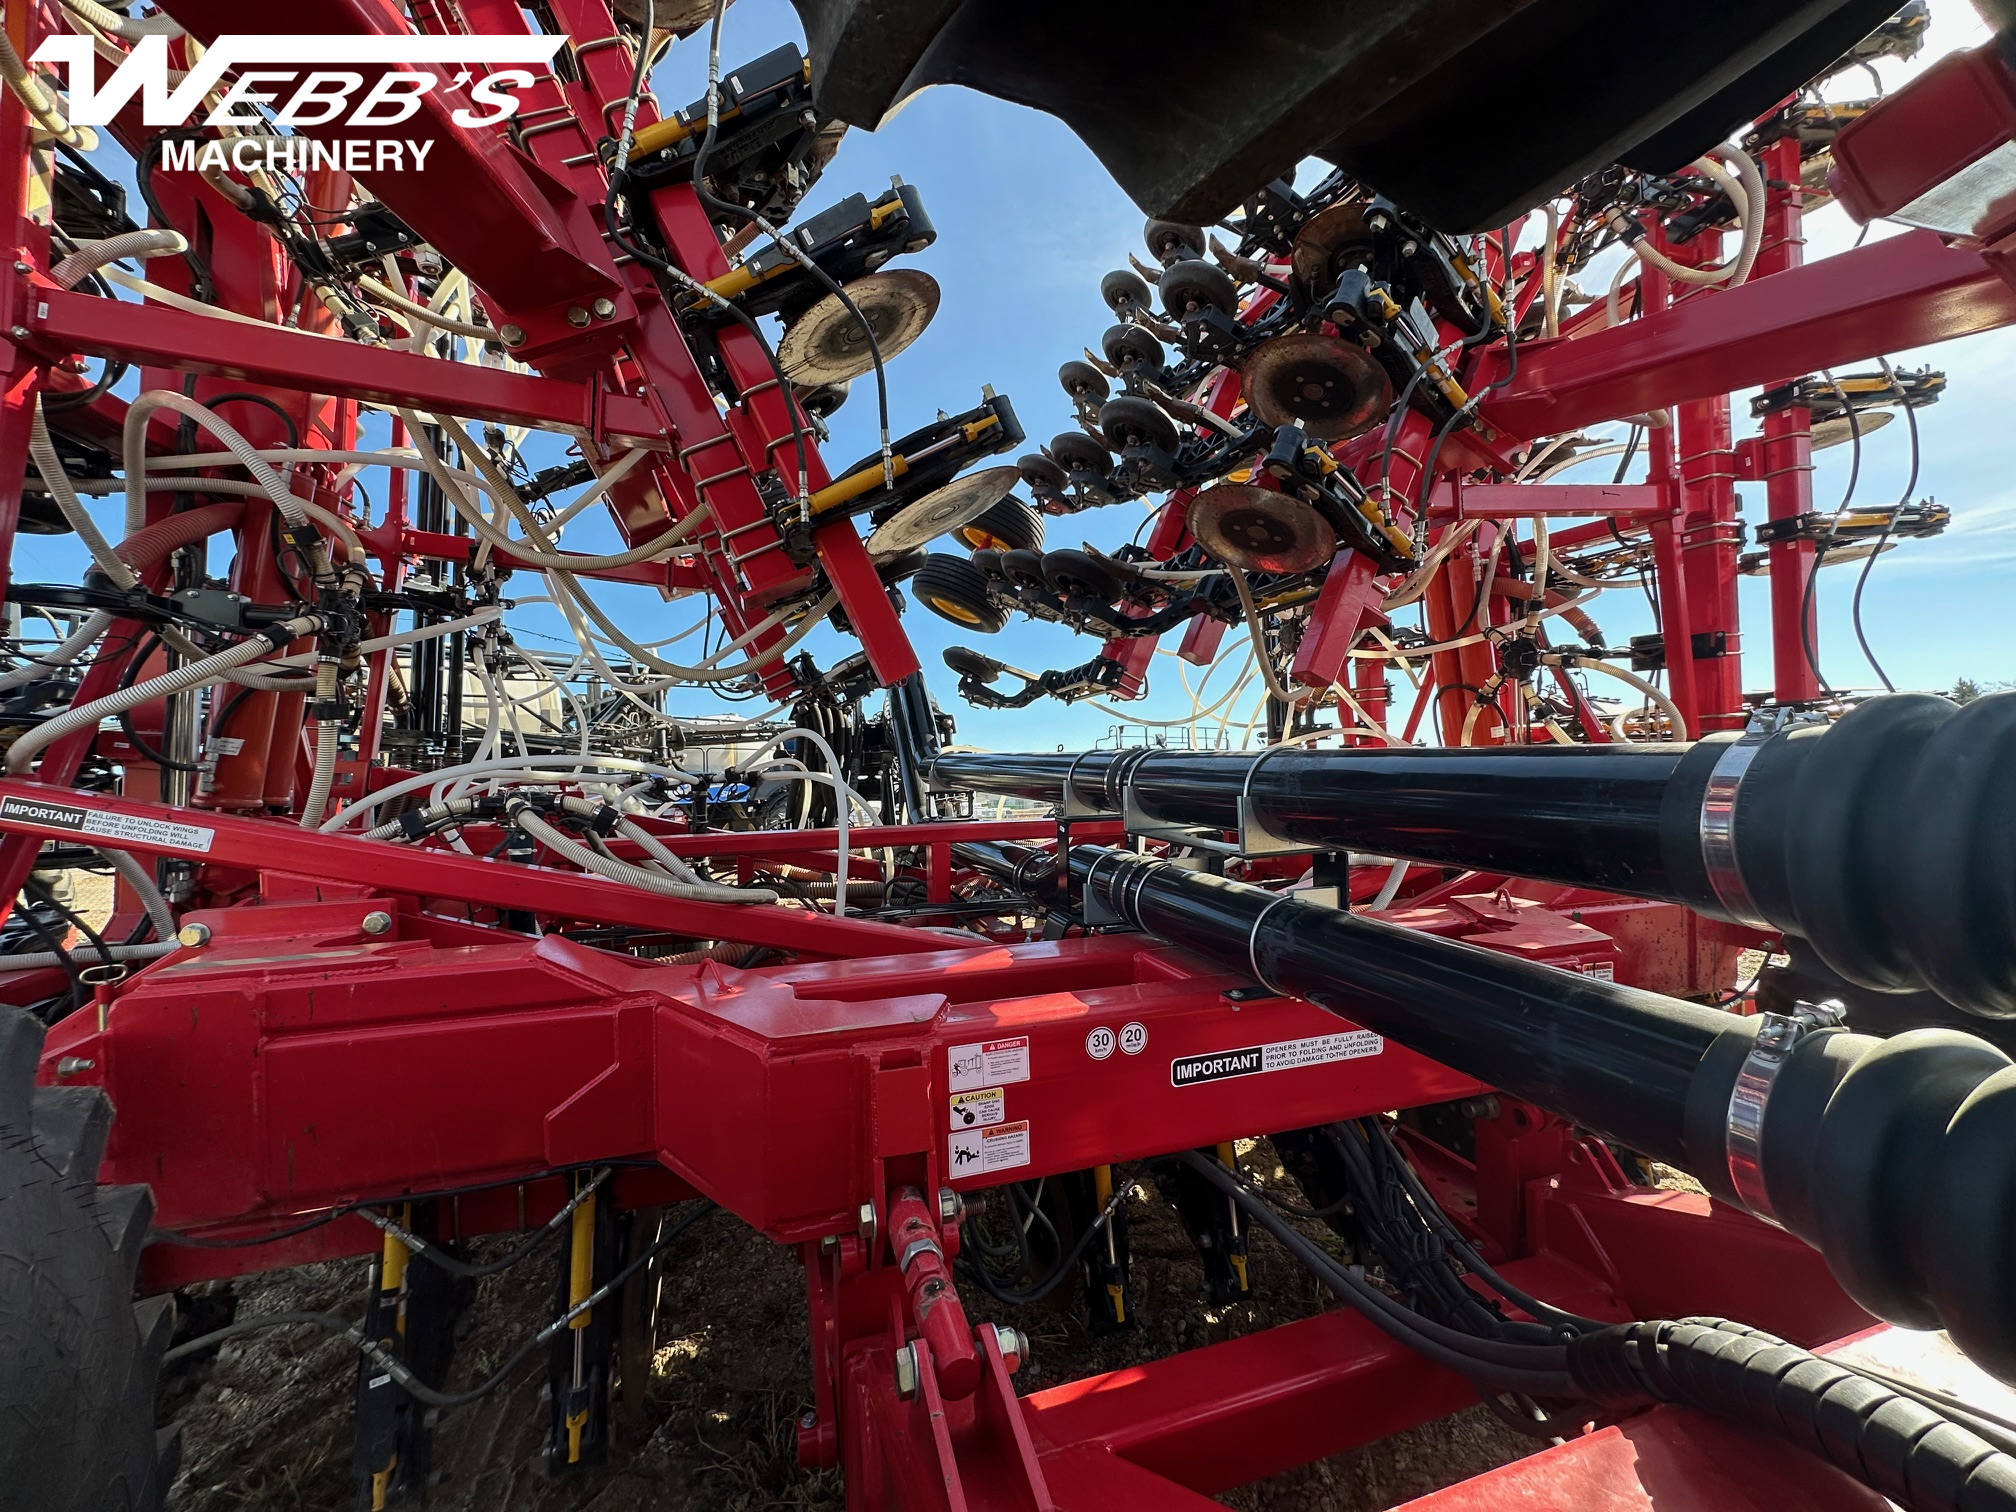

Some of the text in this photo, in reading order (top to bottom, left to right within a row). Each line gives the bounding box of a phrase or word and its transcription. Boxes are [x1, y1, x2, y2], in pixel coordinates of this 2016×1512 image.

[4, 802, 83, 824] IMPORTANT
[86, 818, 189, 840] BEFORE UNFOLDING WILL
[88, 811, 121, 822] FAILURE
[137, 820, 171, 831] UNLOCK
[172, 826, 199, 835] WINGS
[83, 825, 112, 835] CAUSE
[114, 830, 168, 844] STRUCTURAL
[997, 1040, 1021, 1049] DANGER
[1093, 1033, 1109, 1047] 30
[1125, 1028, 1142, 1042] 20
[1265, 1043, 1297, 1054] OPENERS
[1300, 1040, 1318, 1048] MUST
[1334, 1035, 1353, 1043] FULLY
[1265, 1052, 1286, 1061] PRIOR
[1299, 1046, 1327, 1056] FOLDING
[1344, 1039, 1379, 1049] UNFOLDING
[1176, 1053, 1259, 1080] IMPORTANT
[1266, 1061, 1275, 1069] TO
[1276, 1058, 1296, 1067] AVOID
[1297, 1054, 1324, 1064] DAMAGE
[965, 1092, 997, 1102] CAUTION
[996, 1124, 1023, 1134] WARNING
